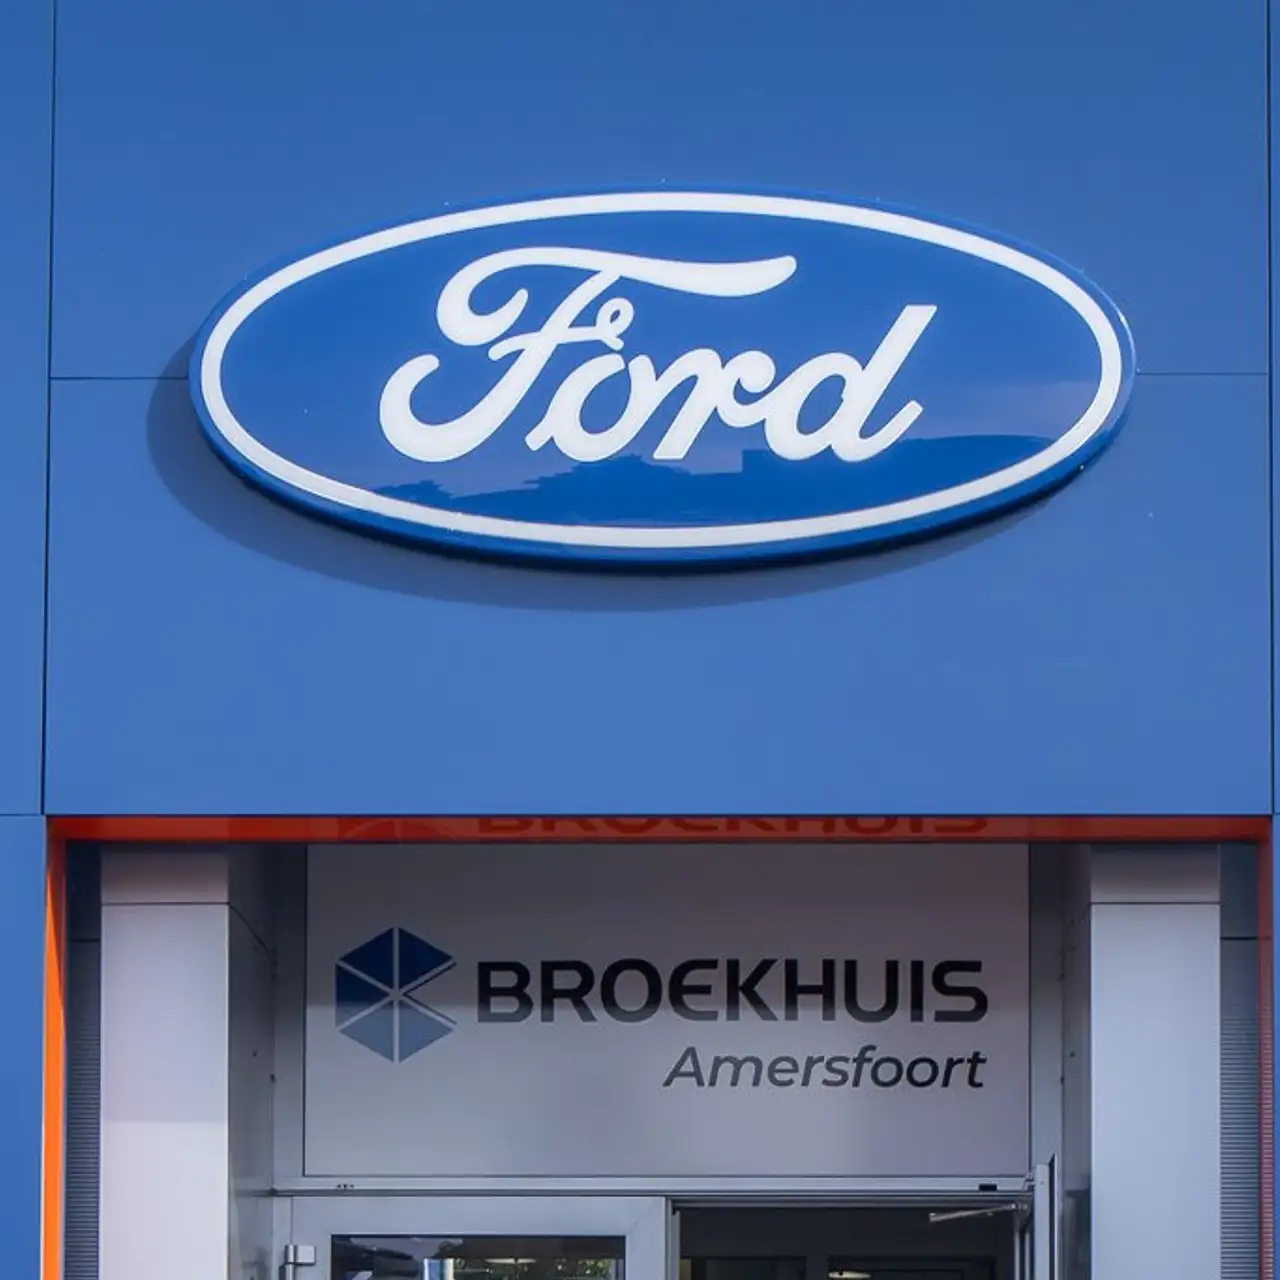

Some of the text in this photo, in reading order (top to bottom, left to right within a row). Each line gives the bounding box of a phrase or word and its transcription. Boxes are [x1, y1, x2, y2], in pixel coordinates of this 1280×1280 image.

[379, 247, 938, 462] Ford
[477, 958, 989, 1023] BROEKHUIS
[663, 1044, 988, 1088] Amersfoort
